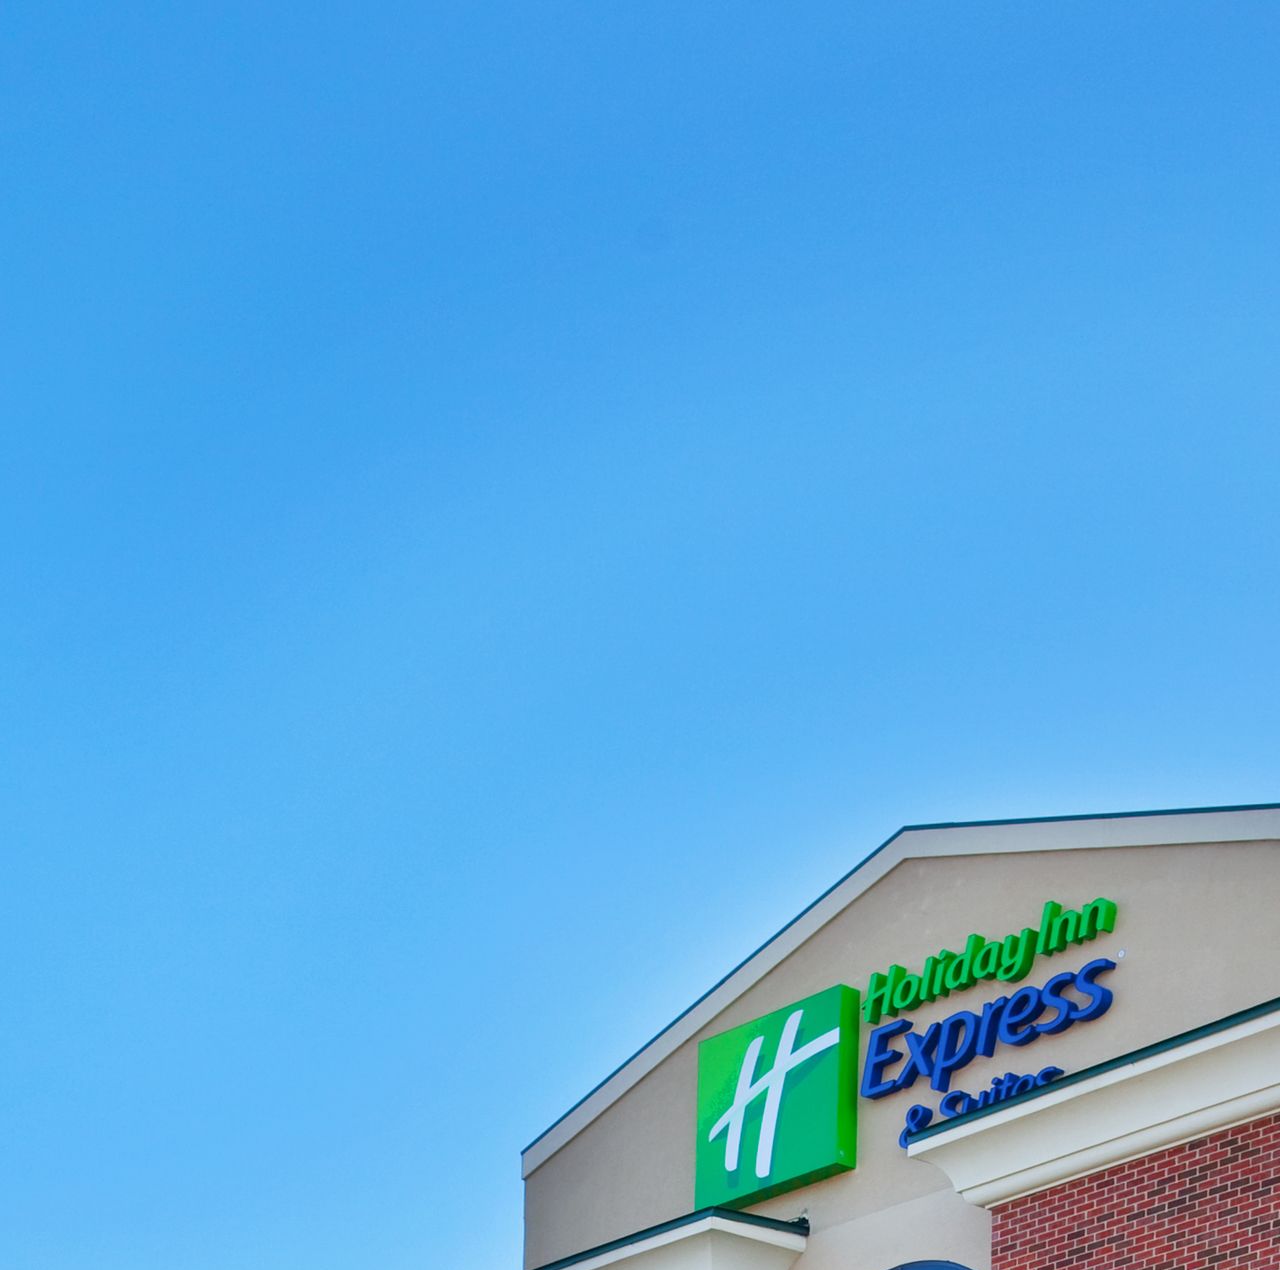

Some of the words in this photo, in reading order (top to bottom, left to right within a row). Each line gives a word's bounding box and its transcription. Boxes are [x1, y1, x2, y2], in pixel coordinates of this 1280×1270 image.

[861, 957, 1117, 1100] Express
[862, 927, 1039, 1025] Holiday
[1036, 898, 1118, 957] Inn
